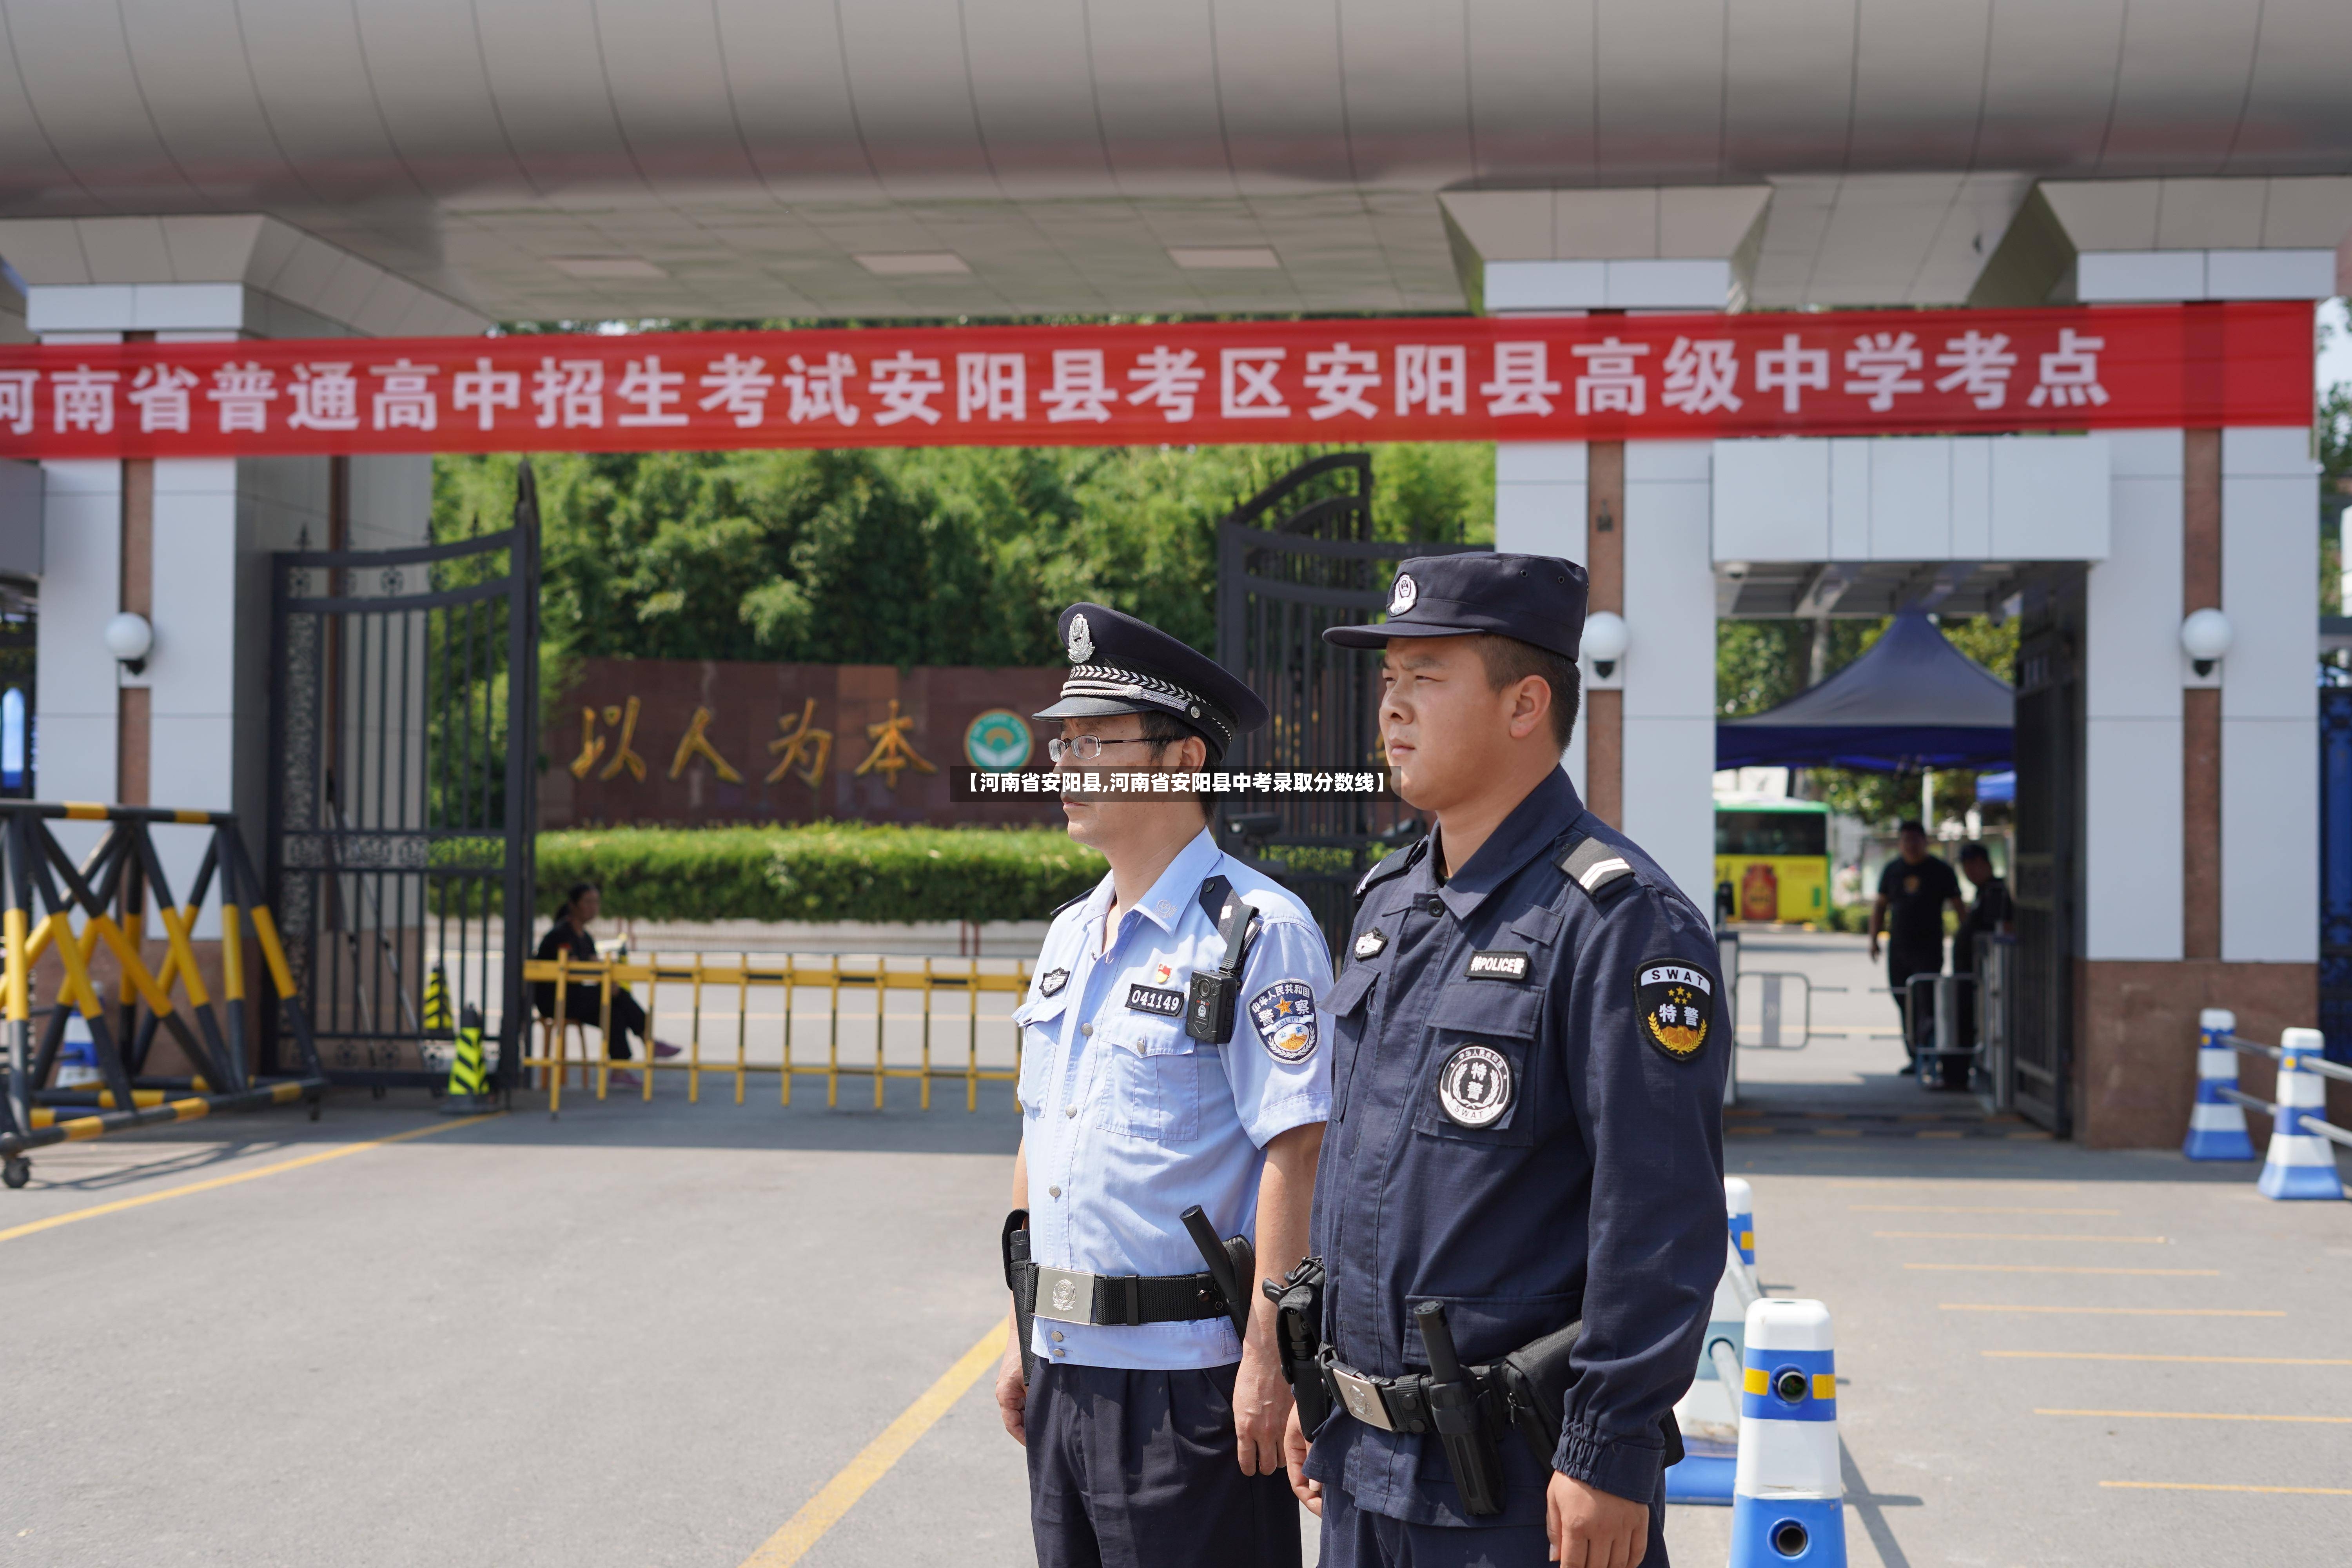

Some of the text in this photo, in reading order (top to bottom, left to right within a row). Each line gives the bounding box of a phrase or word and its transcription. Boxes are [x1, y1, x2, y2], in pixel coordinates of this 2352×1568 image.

[570, 695, 938, 787] 以人为本
[1652, 969, 1703, 986] SWAT
[1132, 990, 1179, 1011] 041149
[1251, 984, 1310, 1013] 中华人民共和国
[1276, 1016, 1303, 1029] POLICE
[1659, 1003, 1699, 1027] 特警
[1455, 1105, 1483, 1118] SWAT
